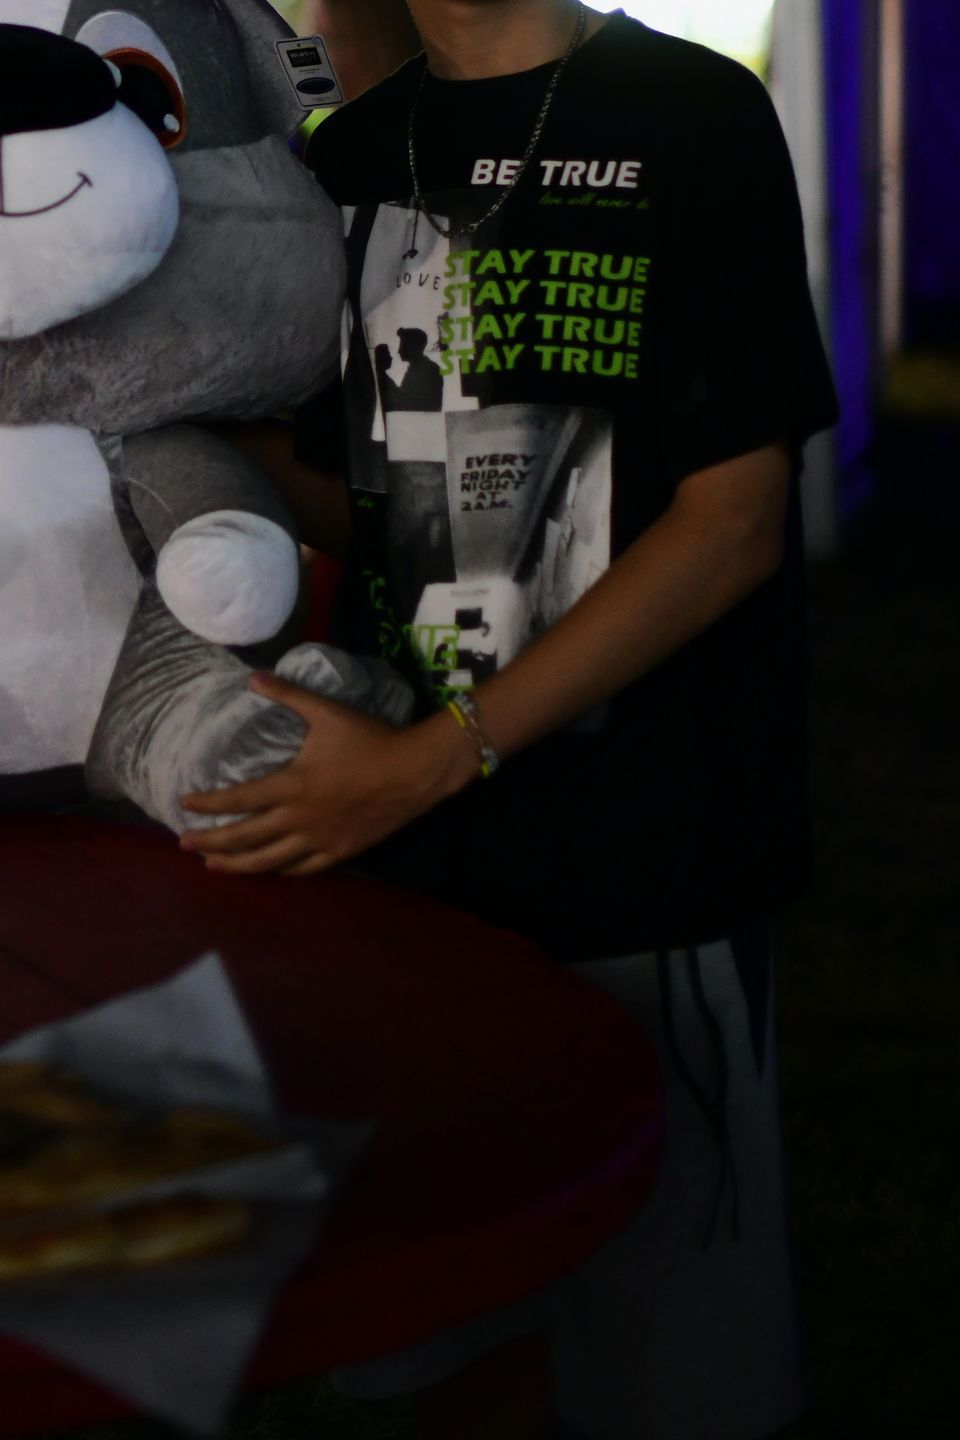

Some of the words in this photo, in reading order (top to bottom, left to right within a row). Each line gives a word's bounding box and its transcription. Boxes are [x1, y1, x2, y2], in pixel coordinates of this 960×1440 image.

[470, 158, 521, 186] BE
[539, 160, 642, 189] TRUE
[444, 249, 536, 278] STAY
[544, 250, 652, 283] TRUE
[396, 271, 441, 290] LOVE
[443, 279, 531, 310] STAY
[539, 280, 647, 314] TRUE
[441, 312, 528, 344] STAY
[535, 314, 641, 347] TRUE
[440, 343, 526, 376] STAY
[533, 345, 640, 380] TRUE
[465, 453, 537, 469] EVERY
[461, 469, 532, 482] FRIDAY
[461, 480, 527, 493] NIGHT
[476, 491, 502, 501] AT
